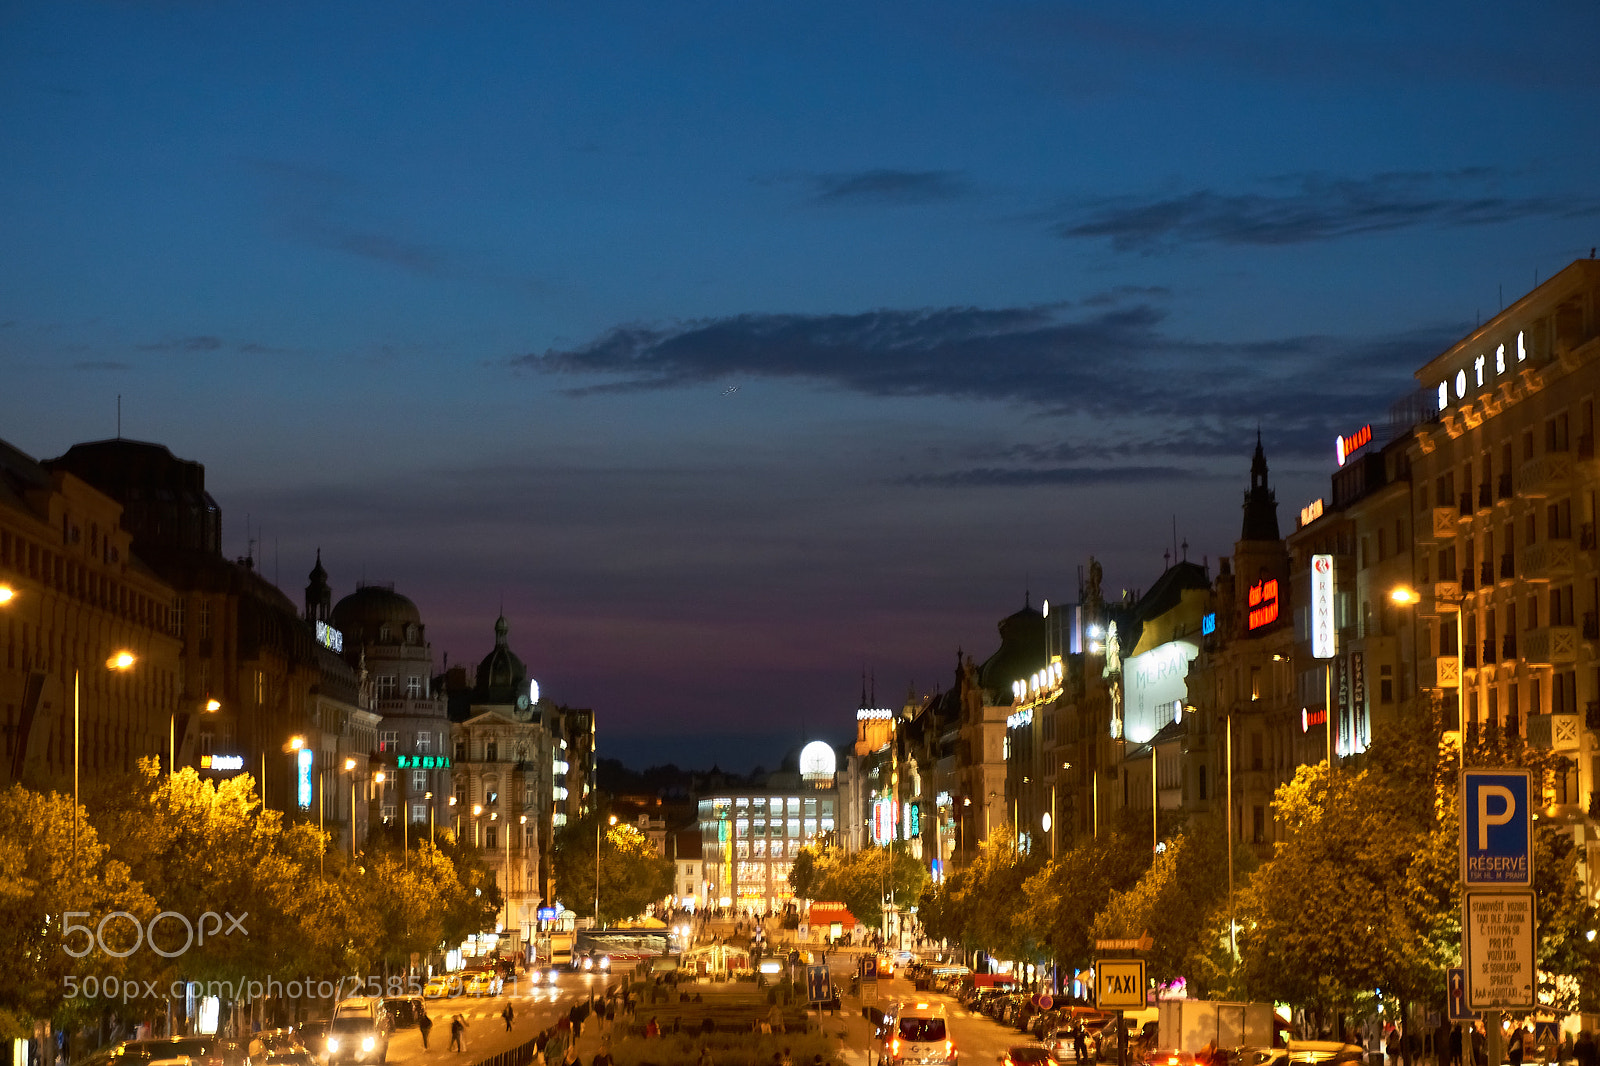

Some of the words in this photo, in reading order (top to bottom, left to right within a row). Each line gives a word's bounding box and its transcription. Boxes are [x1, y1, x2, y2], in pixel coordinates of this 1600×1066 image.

[1438, 330, 1526, 411] HOTEL
[1344, 424, 1372, 457] RAMADA
[1318, 581, 1328, 657] RAMADA
[1478, 784, 1516, 850] P
[1469, 854, 1526, 871] RÉSERVÉ
[1476, 913, 1488, 923] TAXI
[1097, 940, 1115, 948] FAIR
[1489, 938, 1501, 948] PRO
[1503, 950, 1516, 960] TAXI
[864, 960, 873, 975] P
[1106, 975, 1135, 993] TAXI
